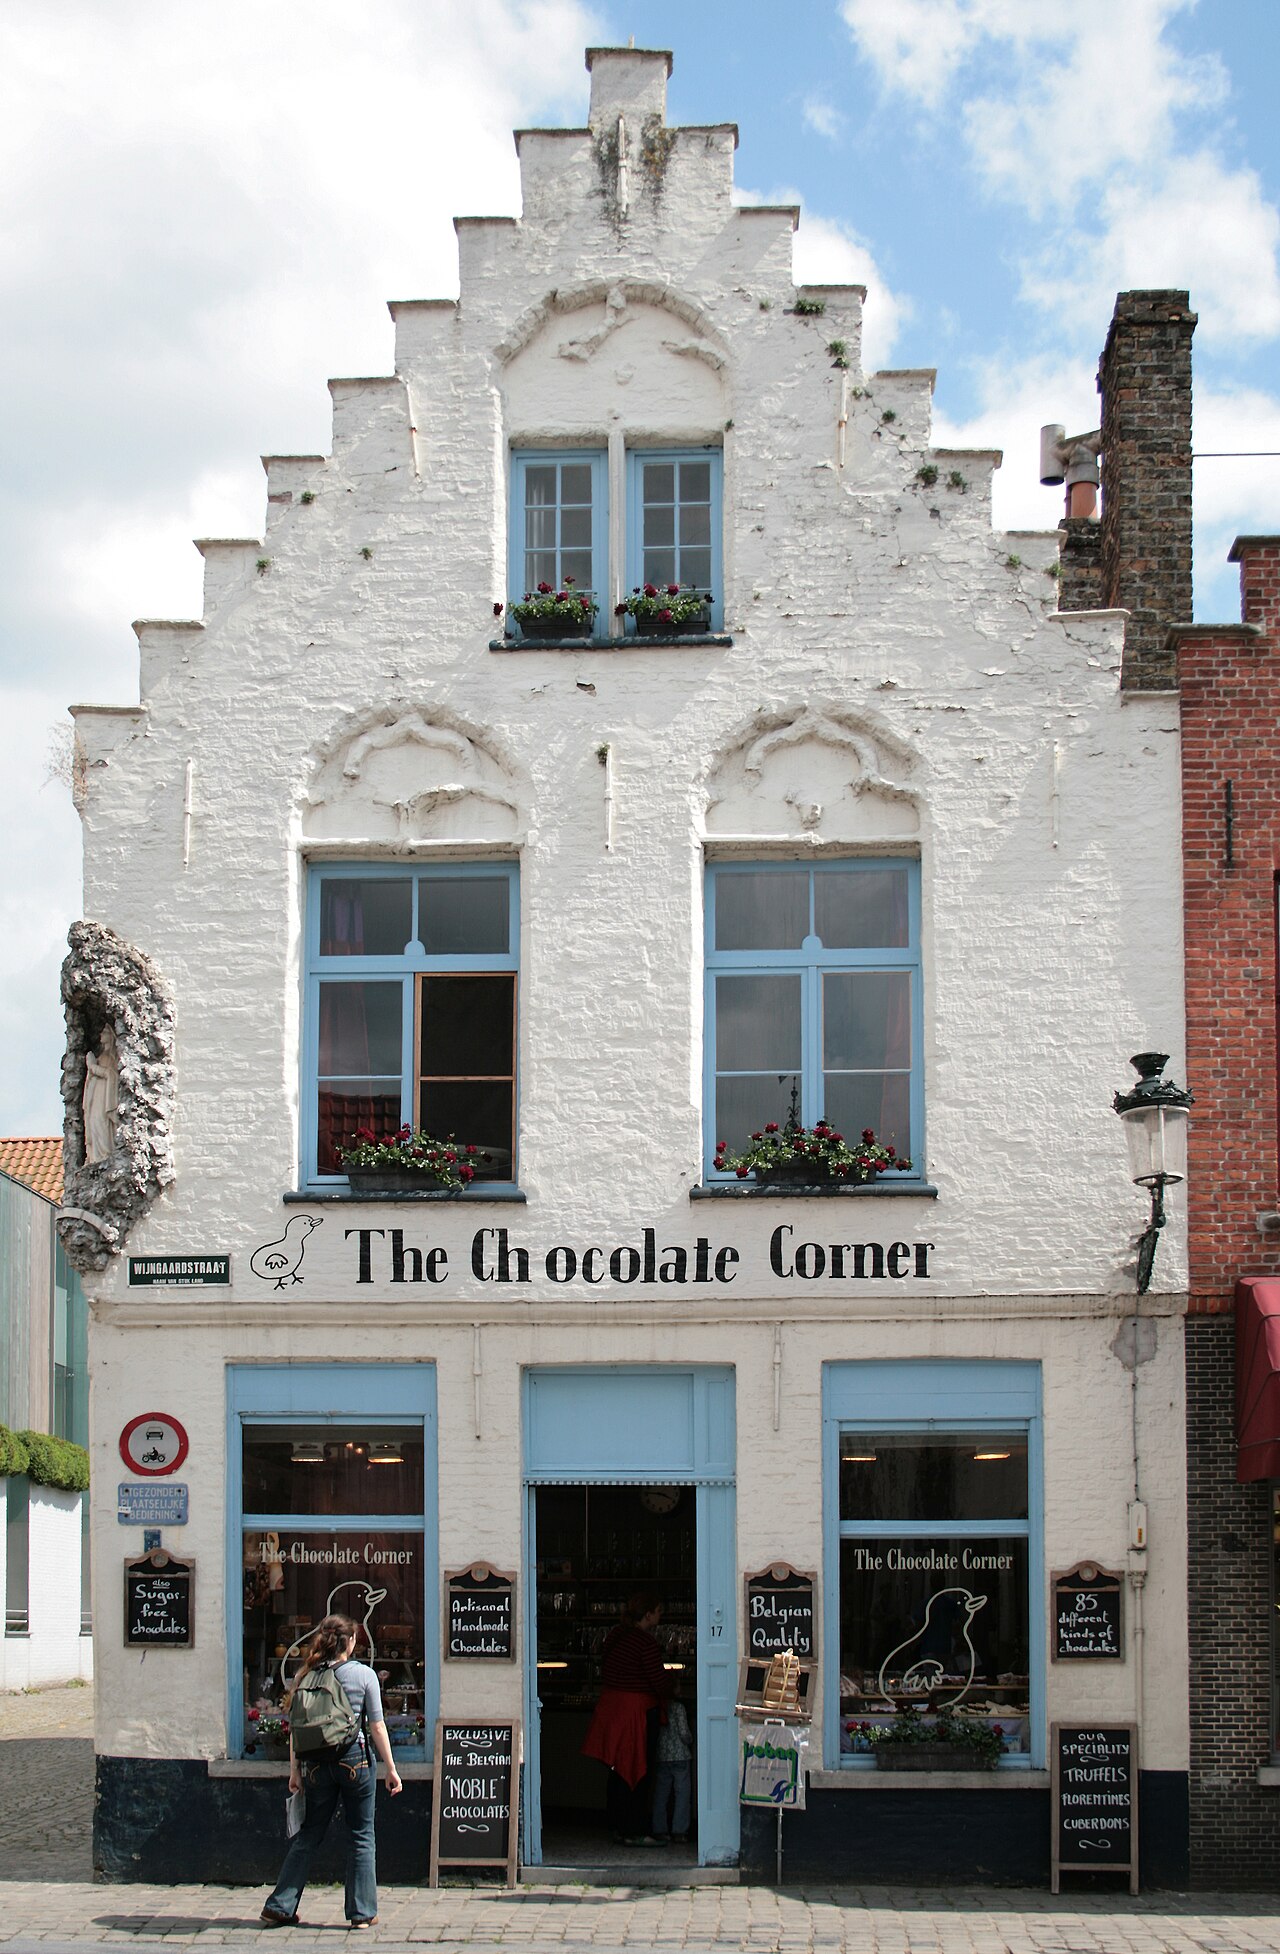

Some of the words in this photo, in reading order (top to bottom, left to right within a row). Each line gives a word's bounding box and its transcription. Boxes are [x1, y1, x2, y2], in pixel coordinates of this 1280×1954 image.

[344, 1229, 449, 1284] The
[470, 1227, 740, 1284] Chocolate
[769, 1224, 936, 1279] Corner
[133, 1261, 226, 1275] WIJNGAARDSTRAAT
[120, 1498, 185, 1509] PLAATSELIJKE
[129, 1510, 176, 1520] BEDIENING
[259, 1541, 287, 1564] The
[291, 1541, 360, 1564] Chocolate
[363, 1543, 413, 1565] Corner
[854, 1548, 883, 1570] The
[886, 1548, 959, 1570] Chocolate
[962, 1548, 1013, 1570] Corner
[152, 1578, 171, 1587] also
[140, 1602, 169, 1618] free
[452, 1597, 510, 1613] Artisanal
[750, 1595, 812, 1625] Belgian
[1075, 1593, 1099, 1612] 85
[131, 1617, 187, 1635] chocolates
[452, 1615, 509, 1632] Handmade
[1058, 1610, 1110, 1628] different
[710, 1625, 723, 1637] 17
[1060, 1627, 1096, 1639] kinds
[1098, 1624, 1114, 1641] of
[450, 1637, 508, 1653] Chocolates
[752, 1626, 810, 1653] Quality
[1059, 1639, 1118, 1653] chocolates
[445, 1728, 511, 1741] EXCLUSIVE
[1078, 1732, 1106, 1742] OUR
[1062, 1742, 1130, 1755] SPECIALITY
[444, 1753, 463, 1766] THE
[1063, 1766, 1128, 1783] TRUFFELS
[443, 1804, 510, 1819] CHOCOLATES
[1063, 1817, 1130, 1830] CUBERDONS
